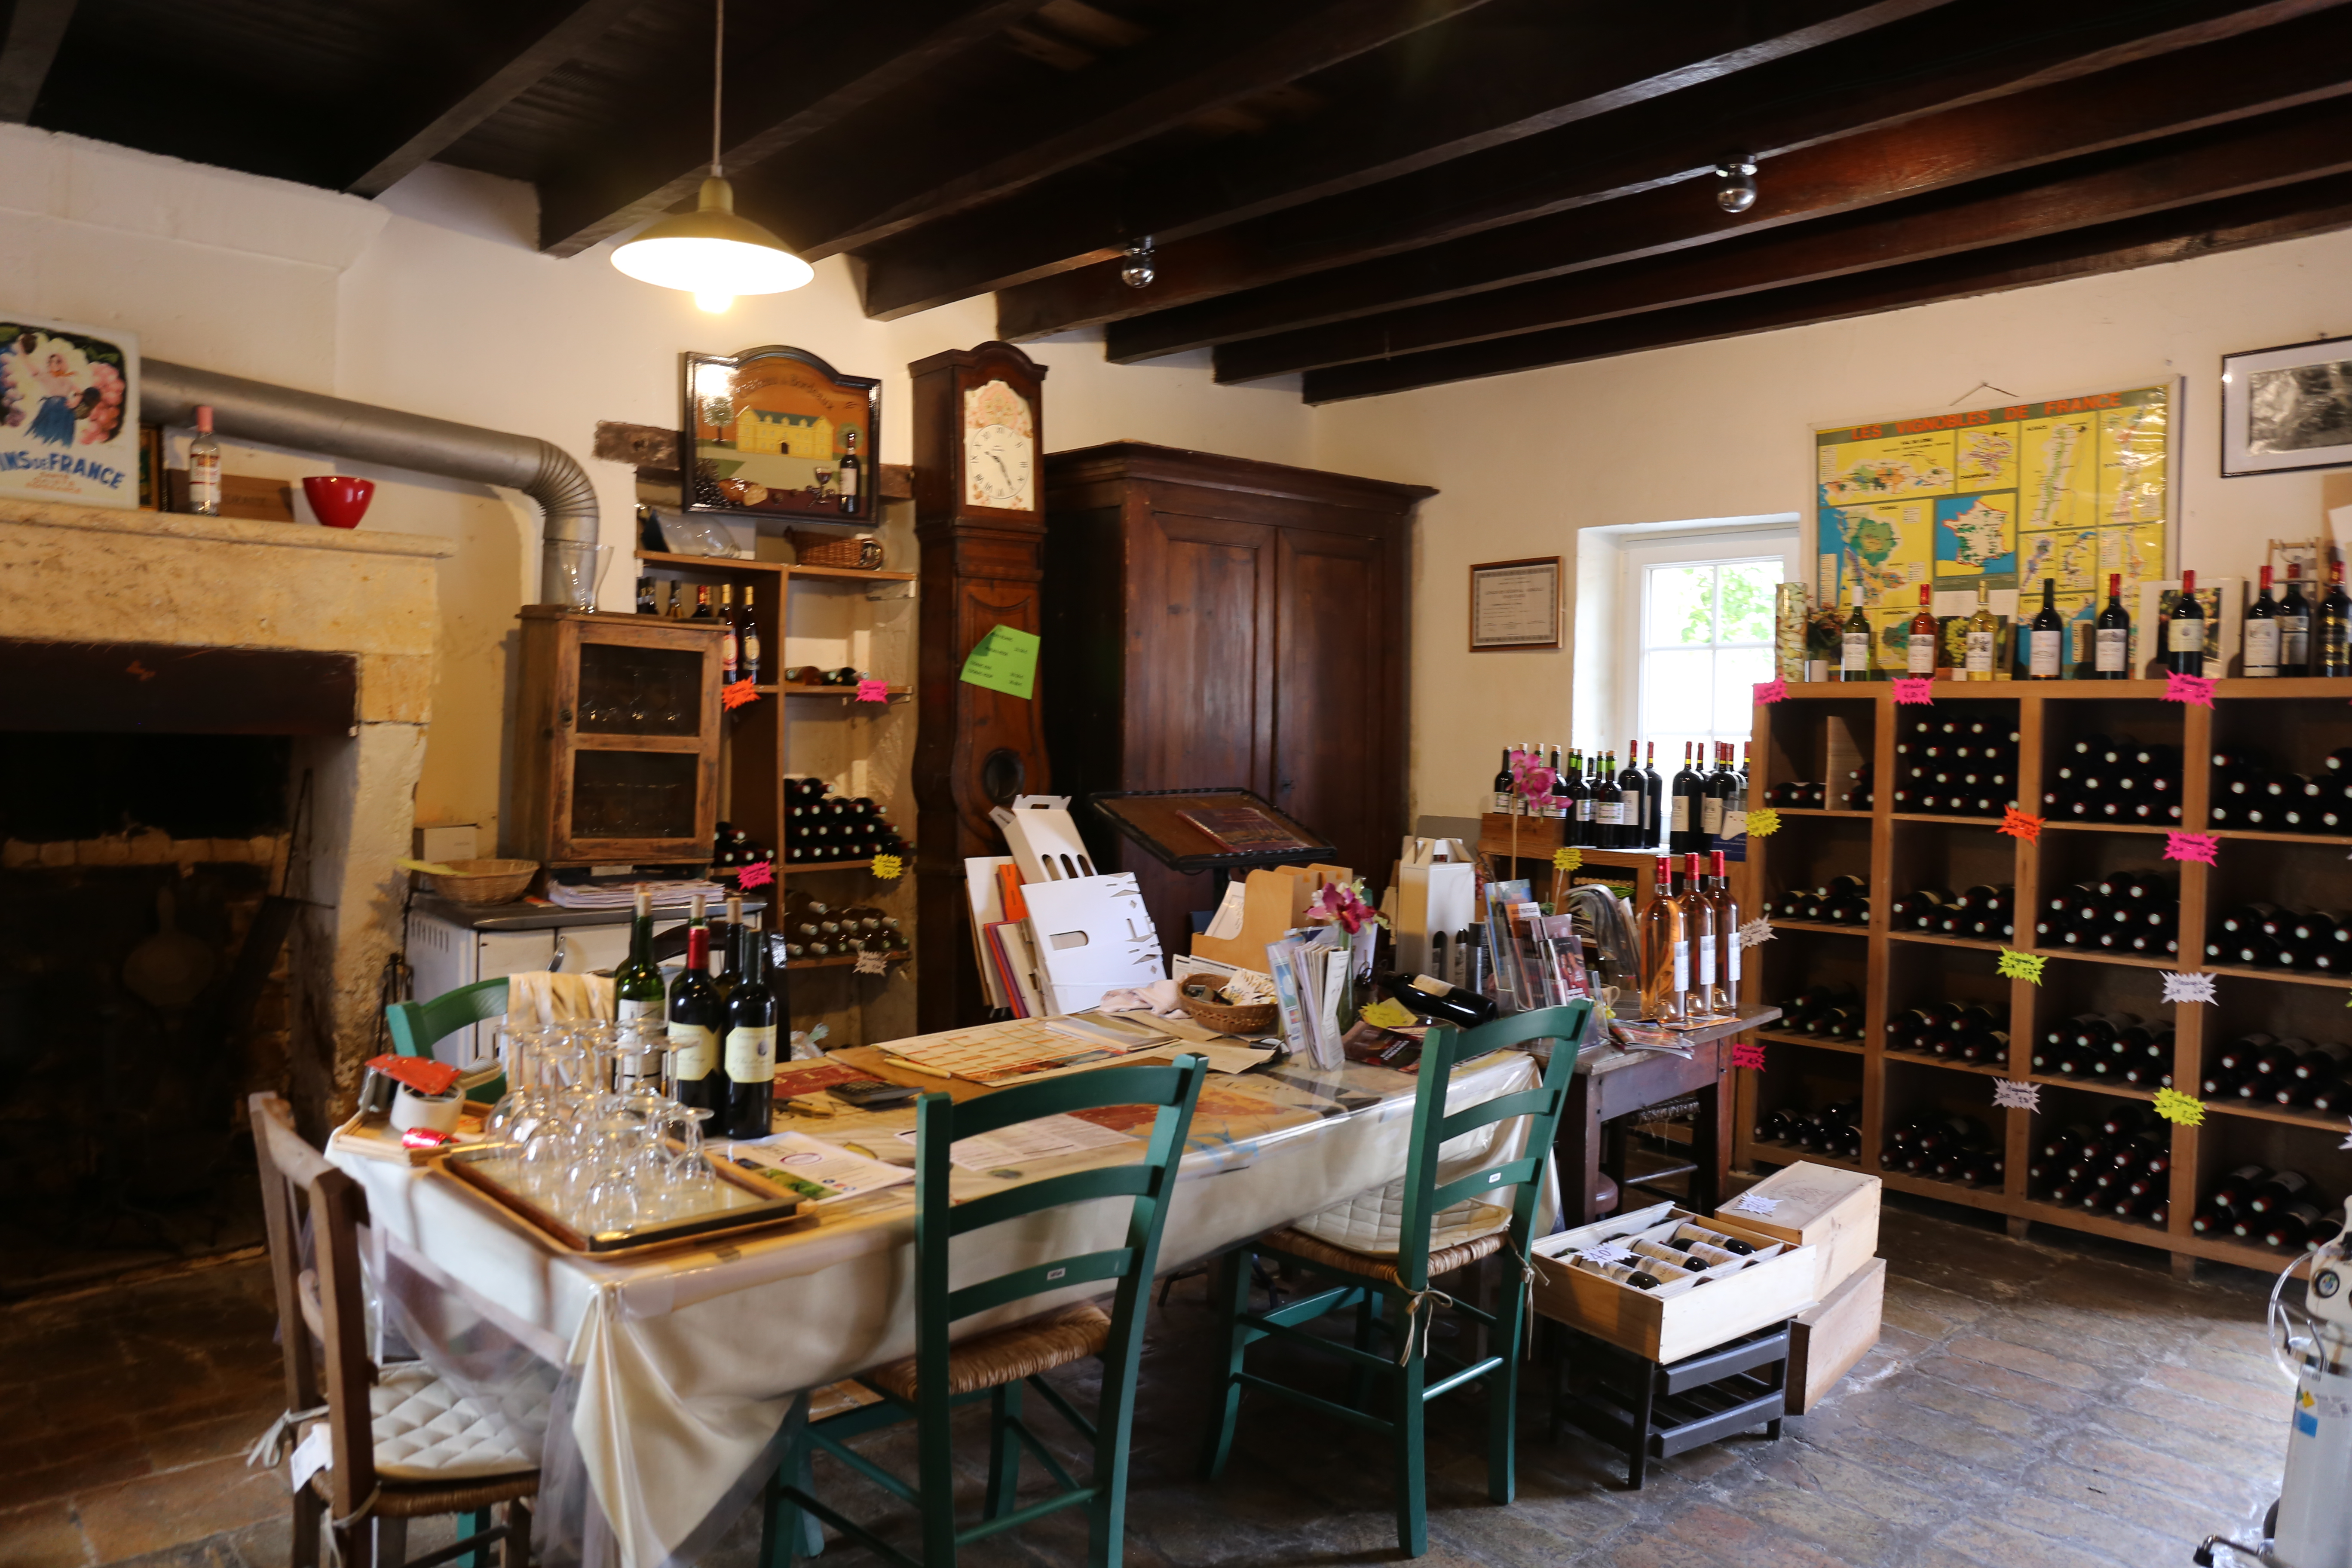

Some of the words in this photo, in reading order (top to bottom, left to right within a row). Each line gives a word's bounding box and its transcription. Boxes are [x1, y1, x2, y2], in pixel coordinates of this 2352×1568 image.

[1851, 424, 1883, 440] LES
[1895, 410, 1991, 435] VIGNOBLES
[2004, 405, 2030, 420] DE
[2043, 392, 2122, 415] FRANCE
[49, 453, 126, 489] FRANCE
